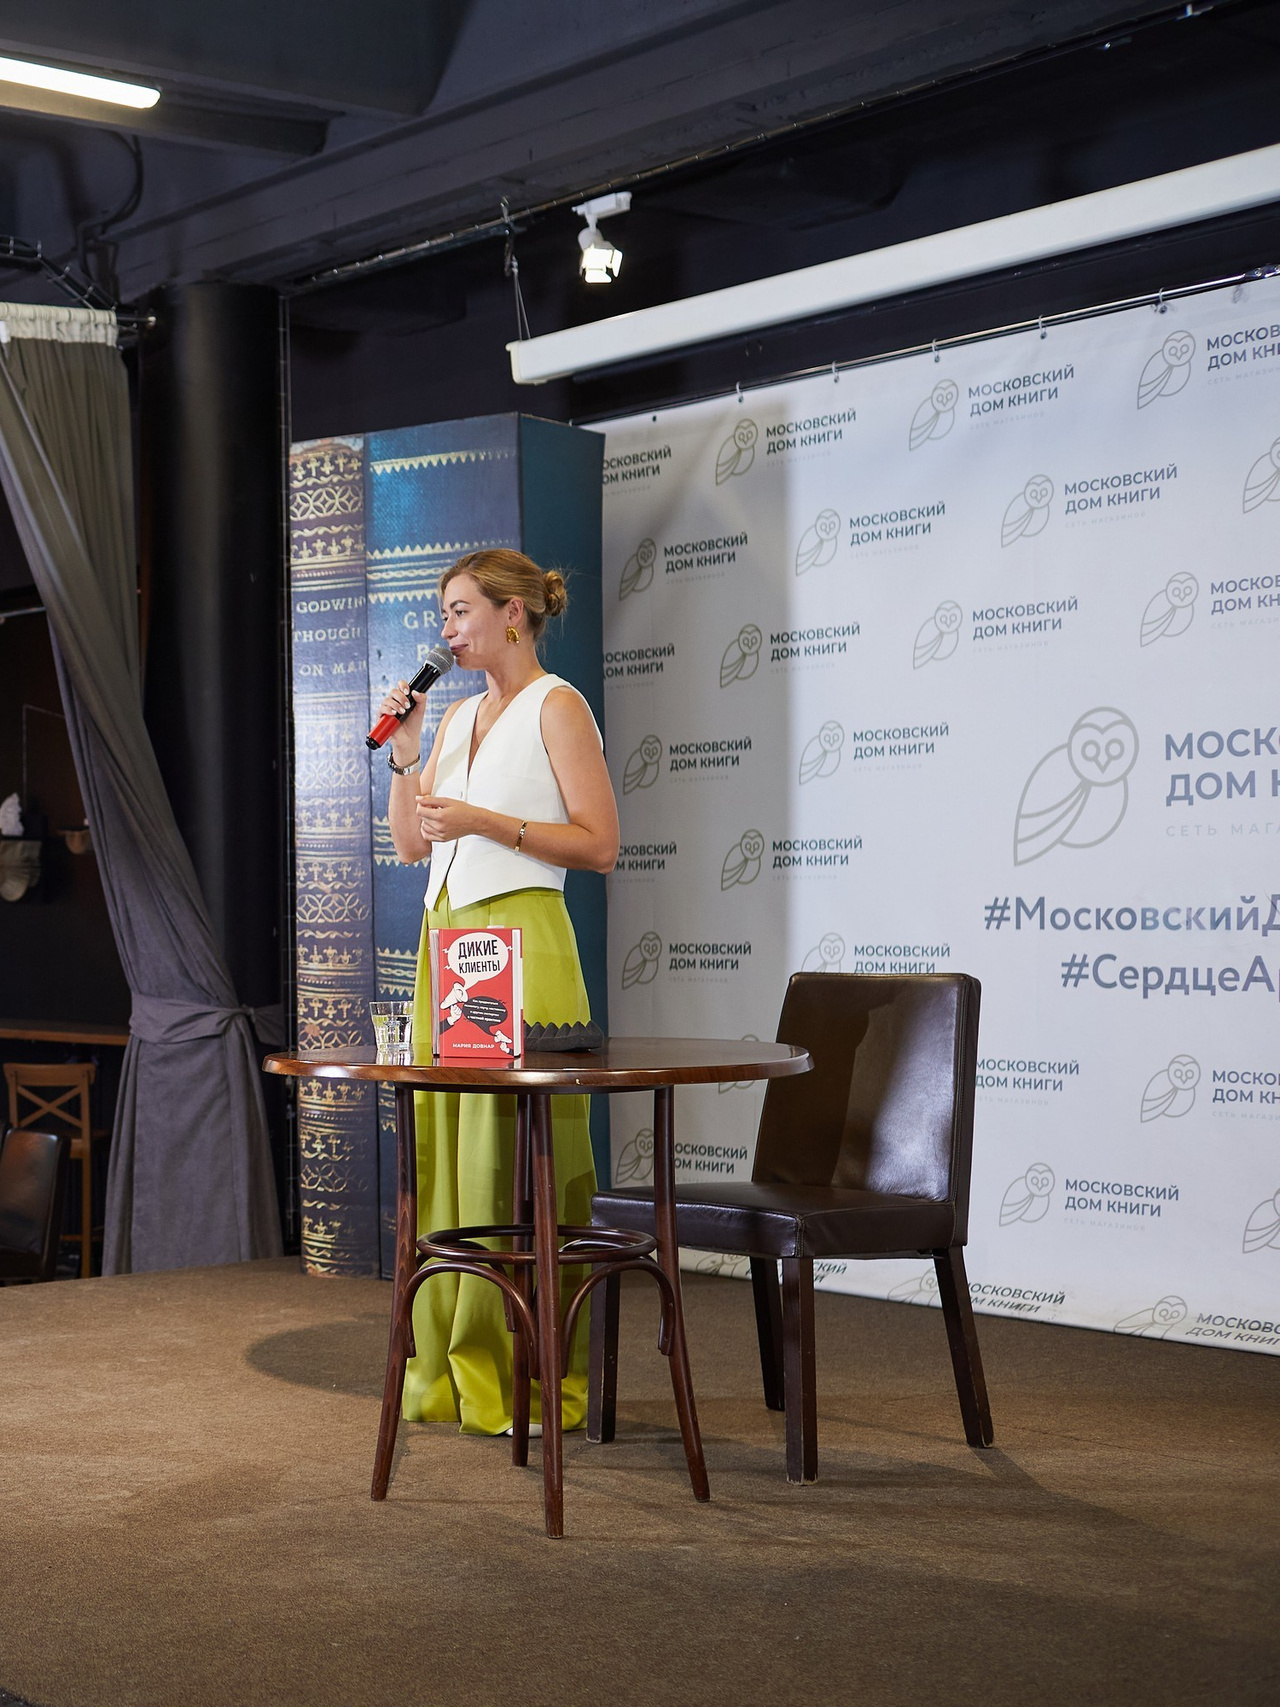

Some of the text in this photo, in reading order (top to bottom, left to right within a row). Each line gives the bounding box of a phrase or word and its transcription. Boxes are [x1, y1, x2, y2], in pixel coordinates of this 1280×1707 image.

[1208, 349, 1247, 372] ДОМ
[968, 363, 1075, 398] МОСКОВСКИЙ
[970, 387, 1059, 418] ДОМ КНИГИ
[766, 408, 857, 438] МОСКОВСКИЙ
[766, 429, 843, 455] ДОМ КНИГИ
[602, 444, 672, 471] ОСКОВСКИЙ
[602, 464, 660, 485] ОМ КНИГИ
[1064, 463, 1178, 495] МОСКОВСКИЙ
[1065, 487, 1160, 515] ДОМ КНИГИ
[849, 501, 946, 529] МОСКОВСКИЙ
[664, 531, 748, 557] МОСКОВСКИЙ
[850, 523, 931, 547] ДОМ КНИГИ
[665, 551, 736, 574] ДОМ КНИГИ
[972, 595, 1078, 622] МОСКОВСКИЙ
[1211, 596, 1252, 616] ДОМ
[403, 610, 438, 630] GR
[973, 618, 1062, 641] ДОМ КНИГИ
[770, 621, 861, 645] МОСКОВСКИЙ
[602, 642, 675, 664] ОСКОВСКИЙ
[771, 642, 847, 662] ДОМ КНИГИ
[299, 664, 323, 677] ON
[603, 661, 664, 679] ОМ КНИГИ
[853, 722, 949, 742] МОСКОВСКИЙ
[669, 736, 752, 756] МОСКОВСКИЙ
[853, 743, 935, 761] ДОМ КНИГИ
[1165, 726, 1280, 761] МОСК
[670, 755, 740, 772] ДОМ КНИГИ
[1166, 770, 1256, 807] ДОМ
[1166, 822, 1280, 837] СЕТЬ МАГ
[772, 835, 863, 852] МОСКОВСКИЙ
[628, 859, 665, 871] КНИГИ
[773, 854, 849, 869] ДОМ КНИГИ
[458, 939, 499, 960] ДИКИЕ
[669, 941, 752, 956] МОСКОВСКИЙ
[854, 943, 950, 957] МОСКОВСКИЙ
[458, 960, 501, 974] КЛИЕНТЫ
[669, 958, 739, 971] ДОМ КНИГИ
[853, 961, 935, 974] ДОМ КНИГИ
[1061, 953, 1280, 1000] #СердцеА
[976, 1058, 1079, 1075] МОСКОВСКИЙ
[975, 1075, 1063, 1092] ДОМ КНИГИ
[1212, 1069, 1280, 1086] МОСКО
[1212, 1088, 1253, 1104] ДОМ
[675, 1142, 748, 1161] ОСКОВСКИЙ
[674, 1158, 735, 1174] ОМ КНИГИ
[1065, 1178, 1179, 1201] МОСКОВСКИЙ
[1064, 1196, 1161, 1217] ДОМ КНИГИ
[968, 1282, 1066, 1305] ОСКОВСКИЙ
[987, 1299, 1041, 1313] КНИГИ
[1185, 1326, 1232, 1338] ДОМ
